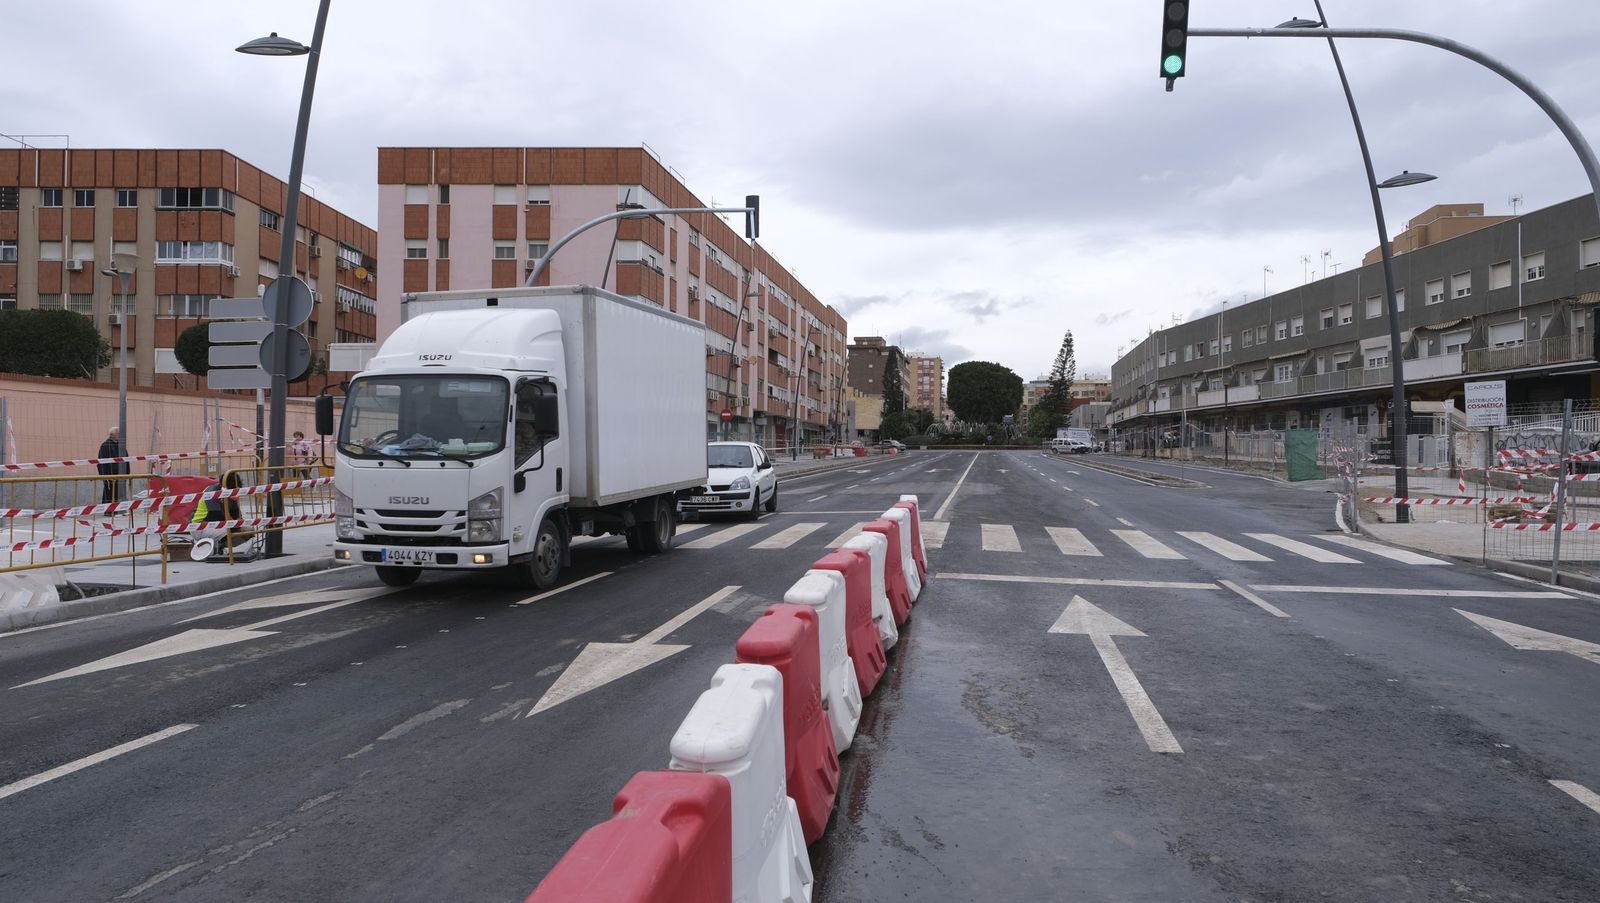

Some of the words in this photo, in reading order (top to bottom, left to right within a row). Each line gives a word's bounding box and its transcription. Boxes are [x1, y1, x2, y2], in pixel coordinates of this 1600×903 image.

[388, 496, 430, 505] ISUZU
[388, 550, 412, 560] 4044
[414, 551, 433, 560] KZY
